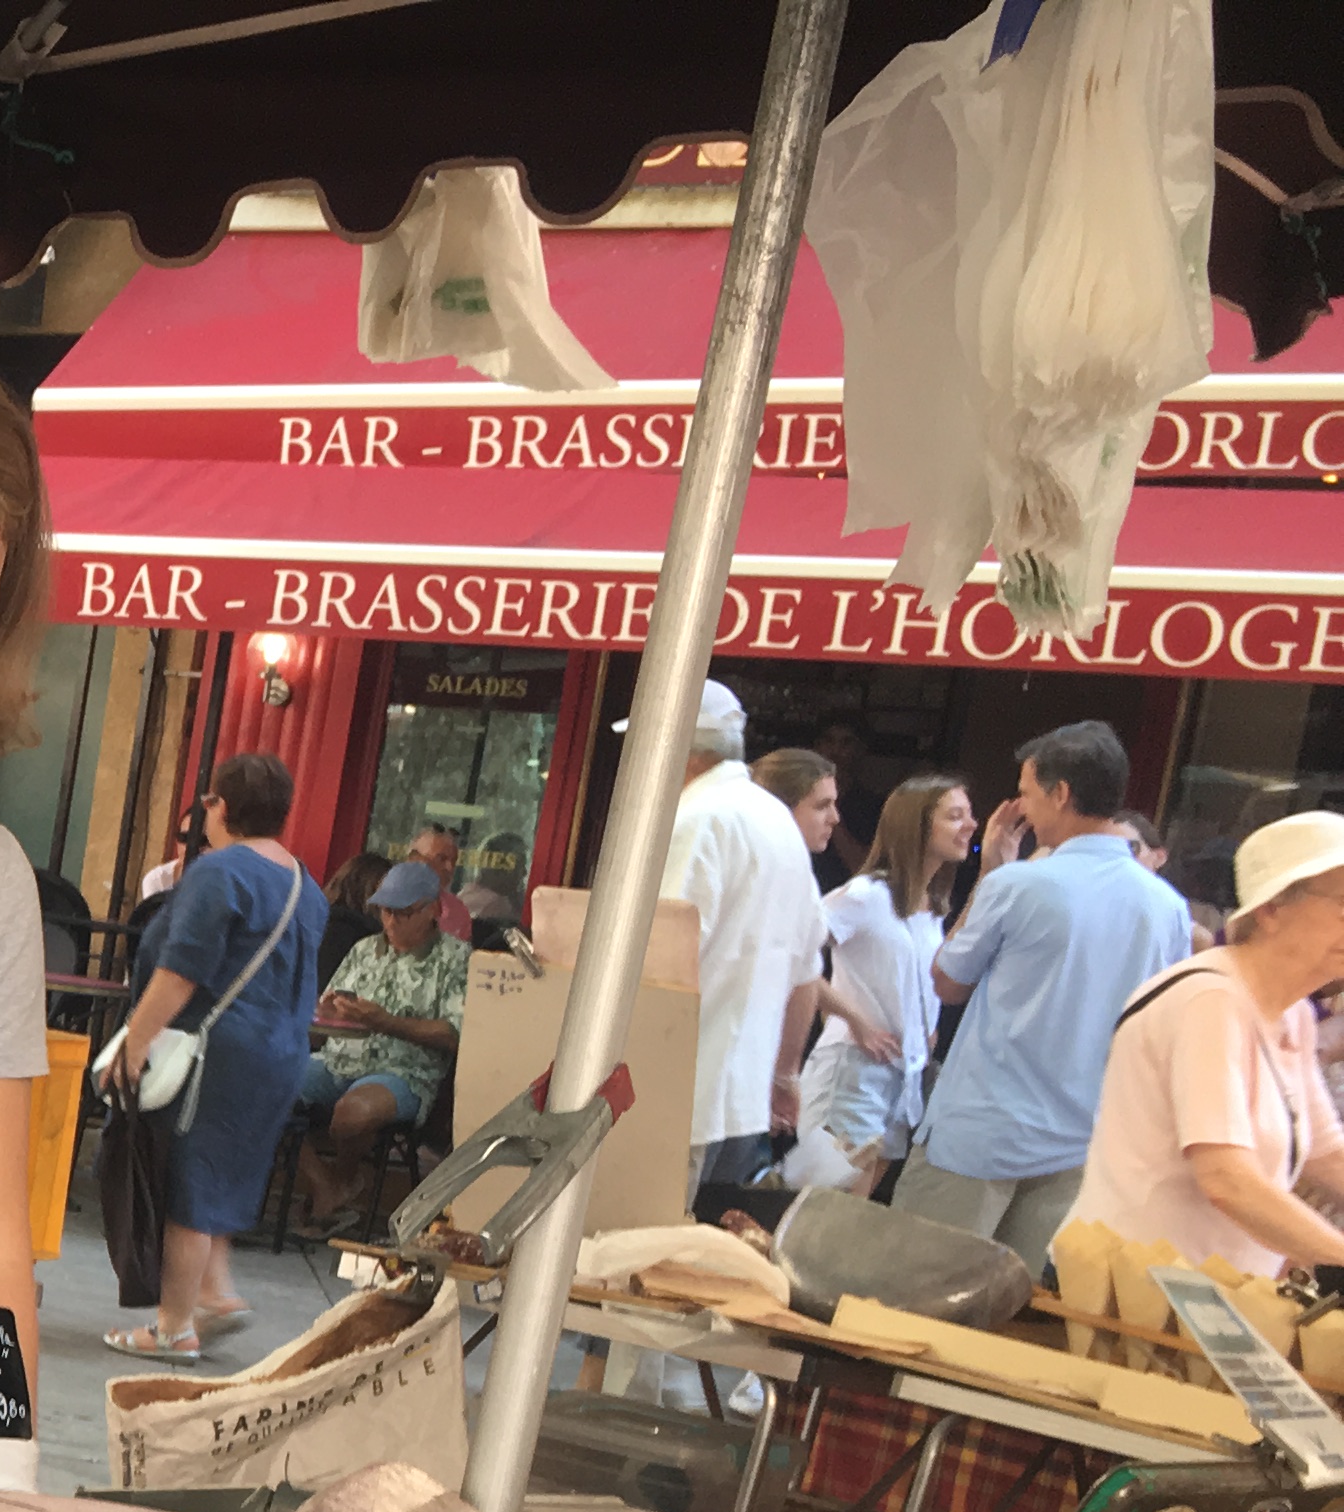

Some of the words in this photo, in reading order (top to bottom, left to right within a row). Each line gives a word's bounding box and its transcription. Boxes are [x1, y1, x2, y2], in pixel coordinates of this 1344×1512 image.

[279, 416, 405, 468] BAR
[463, 411, 844, 470] BRASSIE
[77, 561, 208, 622] BAR
[266, 567, 659, 643] BRASSERIE
[426, 673, 528, 699] SALADES
